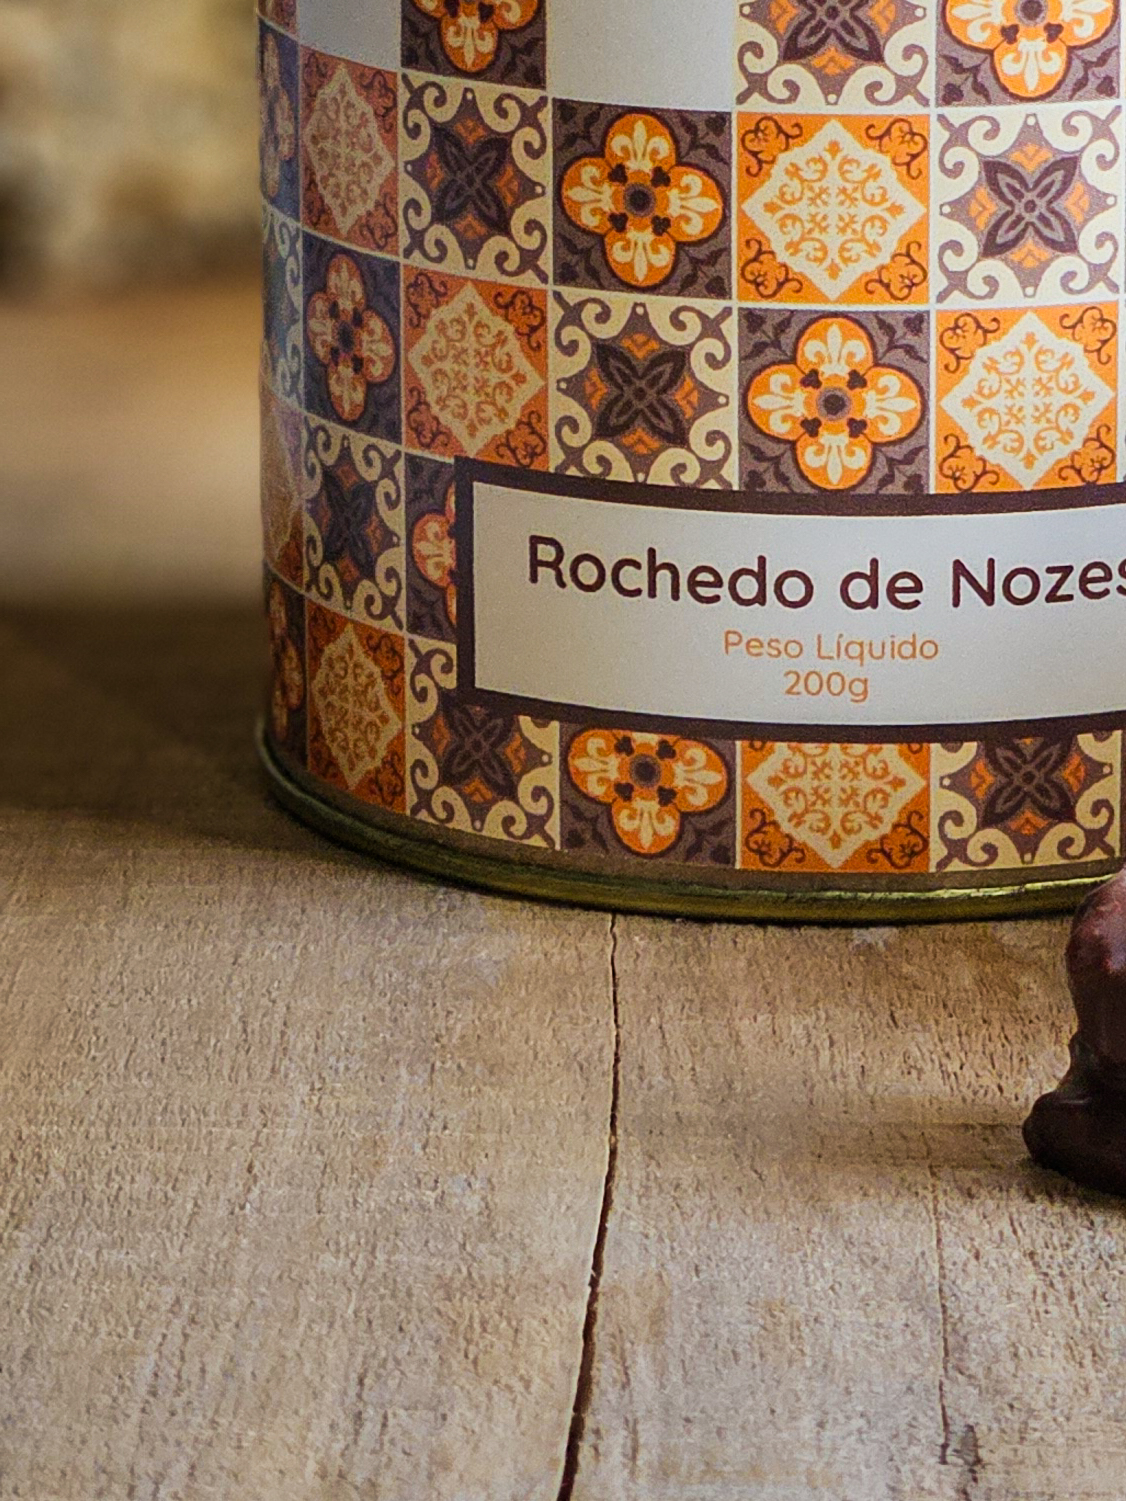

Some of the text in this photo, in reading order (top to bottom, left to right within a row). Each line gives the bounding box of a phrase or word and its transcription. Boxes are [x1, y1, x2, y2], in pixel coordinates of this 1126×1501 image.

[527, 533, 815, 610] Rochedo
[839, 556, 925, 611] de
[723, 629, 940, 665] Peso Líquido
[783, 670, 871, 704] 200g
